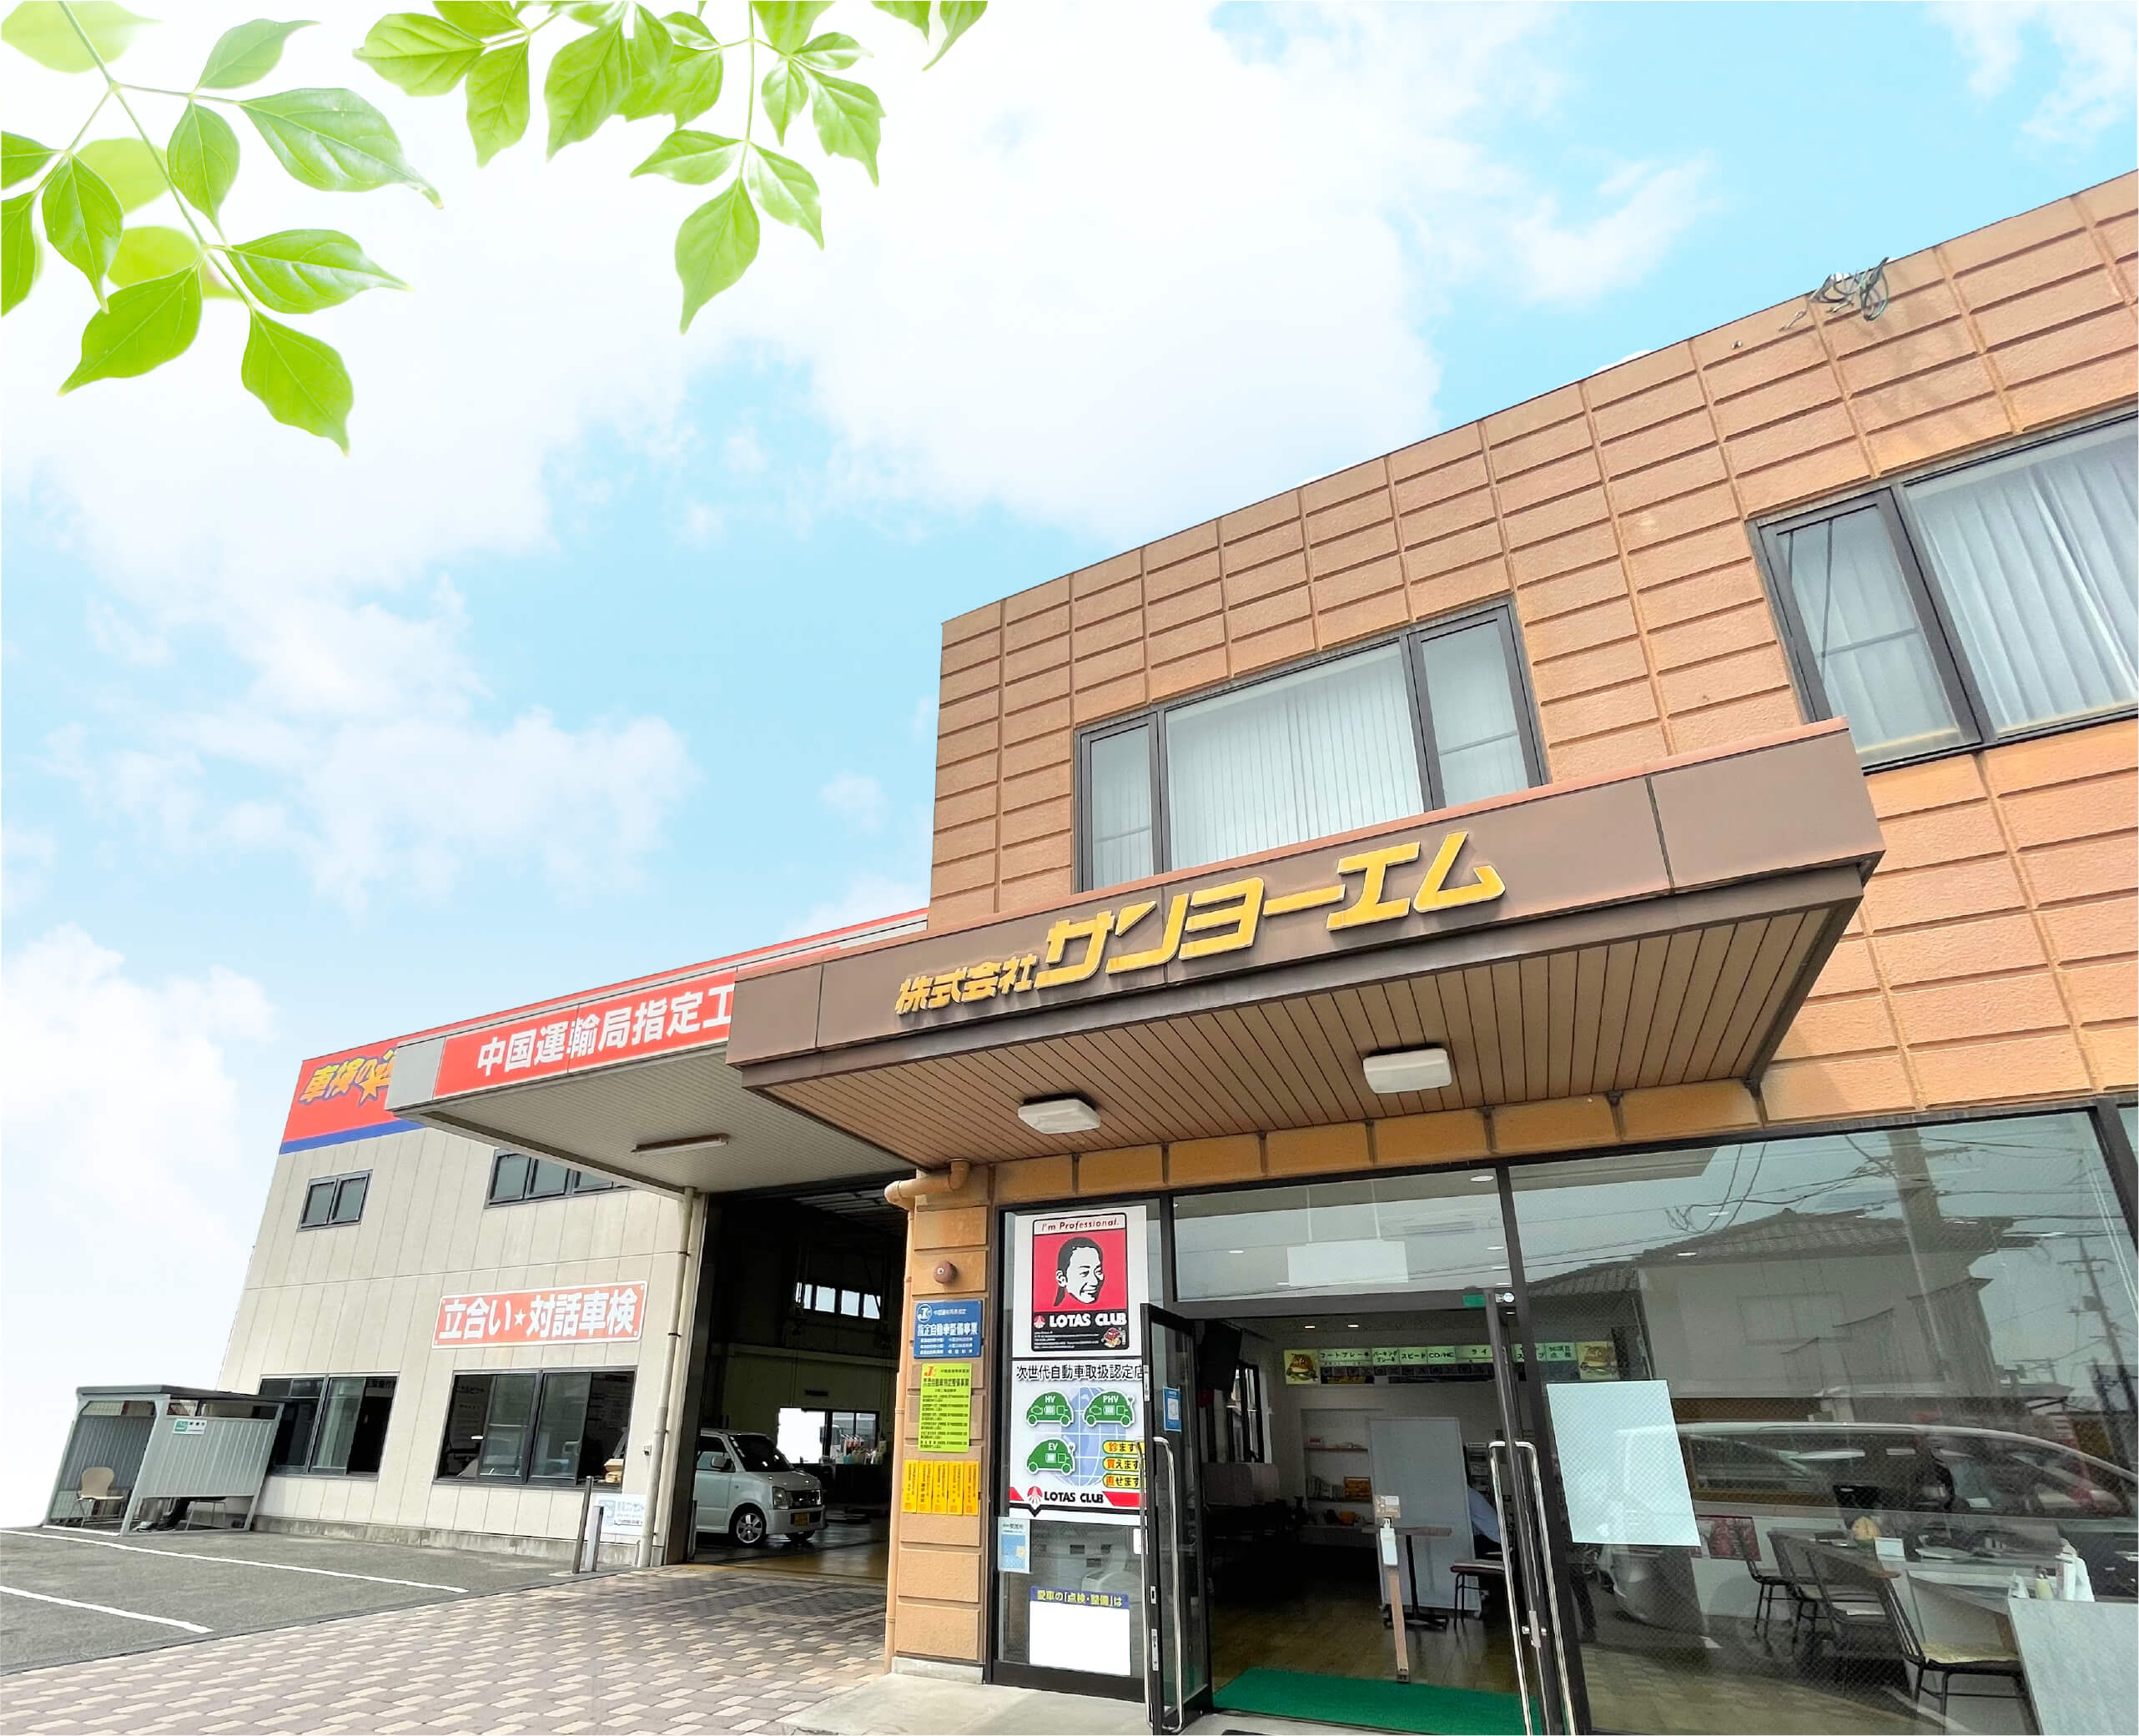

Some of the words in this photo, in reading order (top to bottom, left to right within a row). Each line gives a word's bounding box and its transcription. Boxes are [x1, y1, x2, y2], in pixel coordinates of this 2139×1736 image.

[1059, 1217, 1120, 1230] Professional.
[1049, 1313, 1091, 1328] LOTAS
[1095, 1312, 1128, 1326] CLUB
[1016, 1364, 1144, 1380] 次世代自動車取扱認定店
[1044, 1395, 1055, 1403] HV
[1102, 1395, 1120, 1403] PHV
[1048, 1442, 1058, 1451] EV
[1044, 1491, 1076, 1503] LOTAS
[1080, 1492, 1104, 1504] CLUB
